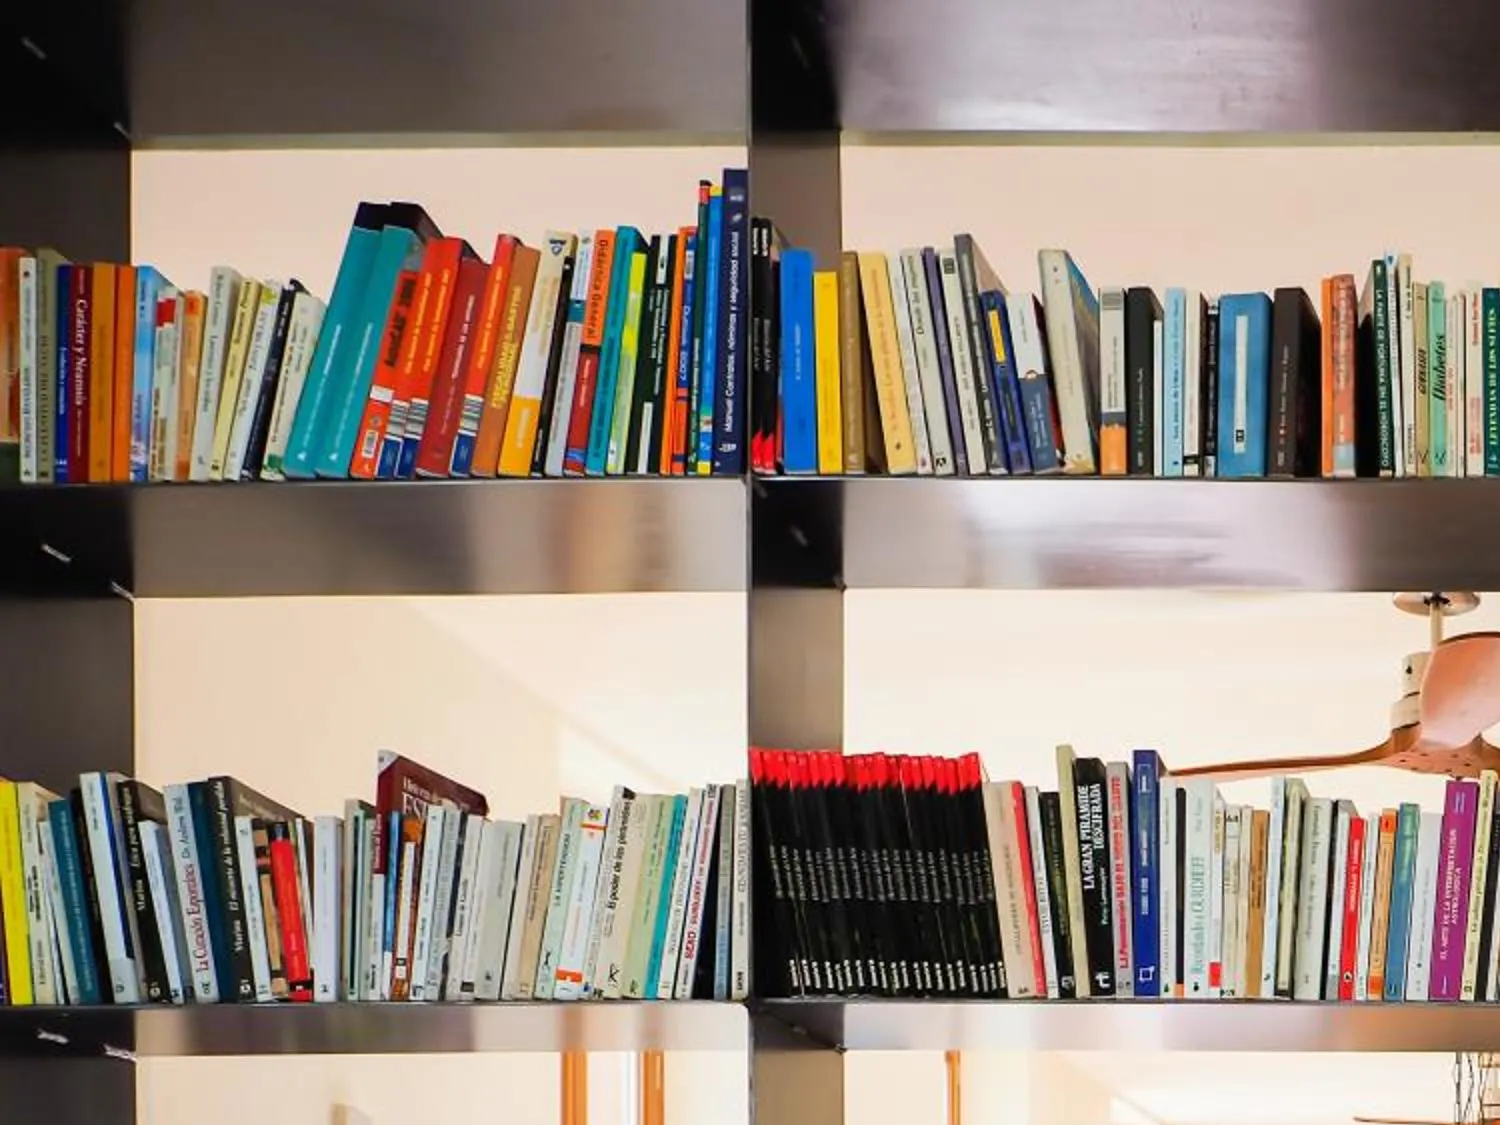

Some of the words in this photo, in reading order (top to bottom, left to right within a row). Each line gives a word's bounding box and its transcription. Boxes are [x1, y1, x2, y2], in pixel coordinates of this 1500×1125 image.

[591, 239, 609, 291] Didáctica
[585, 293, 604, 340] General
[1076, 785, 1092, 840] PIRAMIDE
[1090, 783, 1105, 849] DESCIFRADA
[611, 861, 620, 872] de
[1080, 843, 1094, 875] GRAN
[608, 874, 621, 901] poder
[1082, 876, 1095, 889] LA
[606, 902, 616, 910] El
